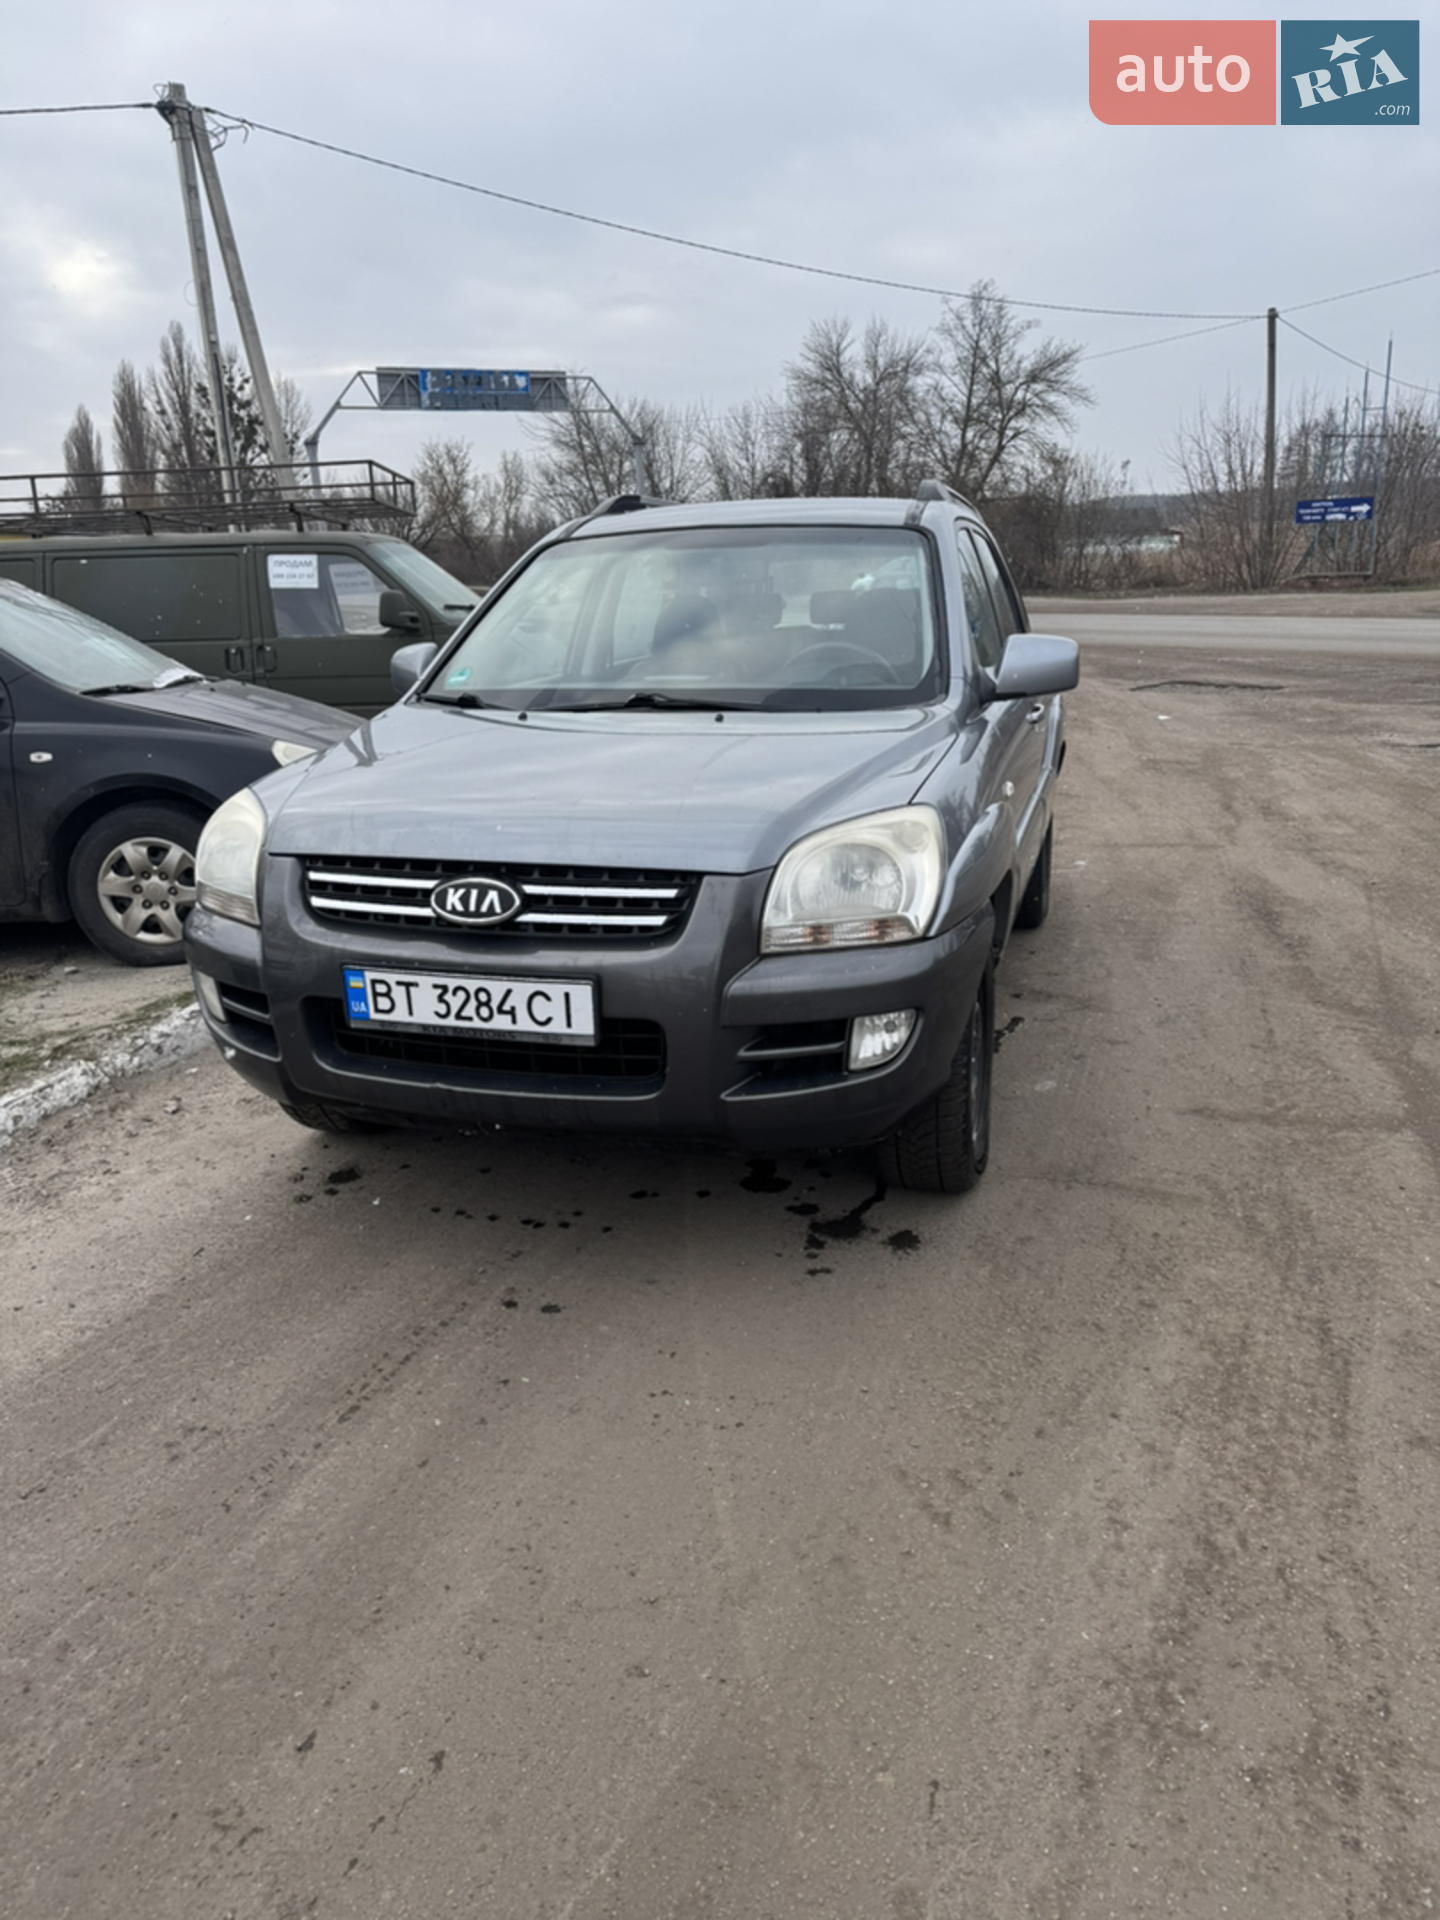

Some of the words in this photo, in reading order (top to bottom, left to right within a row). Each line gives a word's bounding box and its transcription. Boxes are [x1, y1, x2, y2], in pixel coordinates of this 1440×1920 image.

[273, 559, 313, 569] ПРОДАМ
[446, 888, 502, 913] KIA
[351, 1001, 368, 1014] UA
[369, 979, 420, 1017] BT
[432, 983, 518, 1026] 3284
[526, 990, 573, 1029] CI
